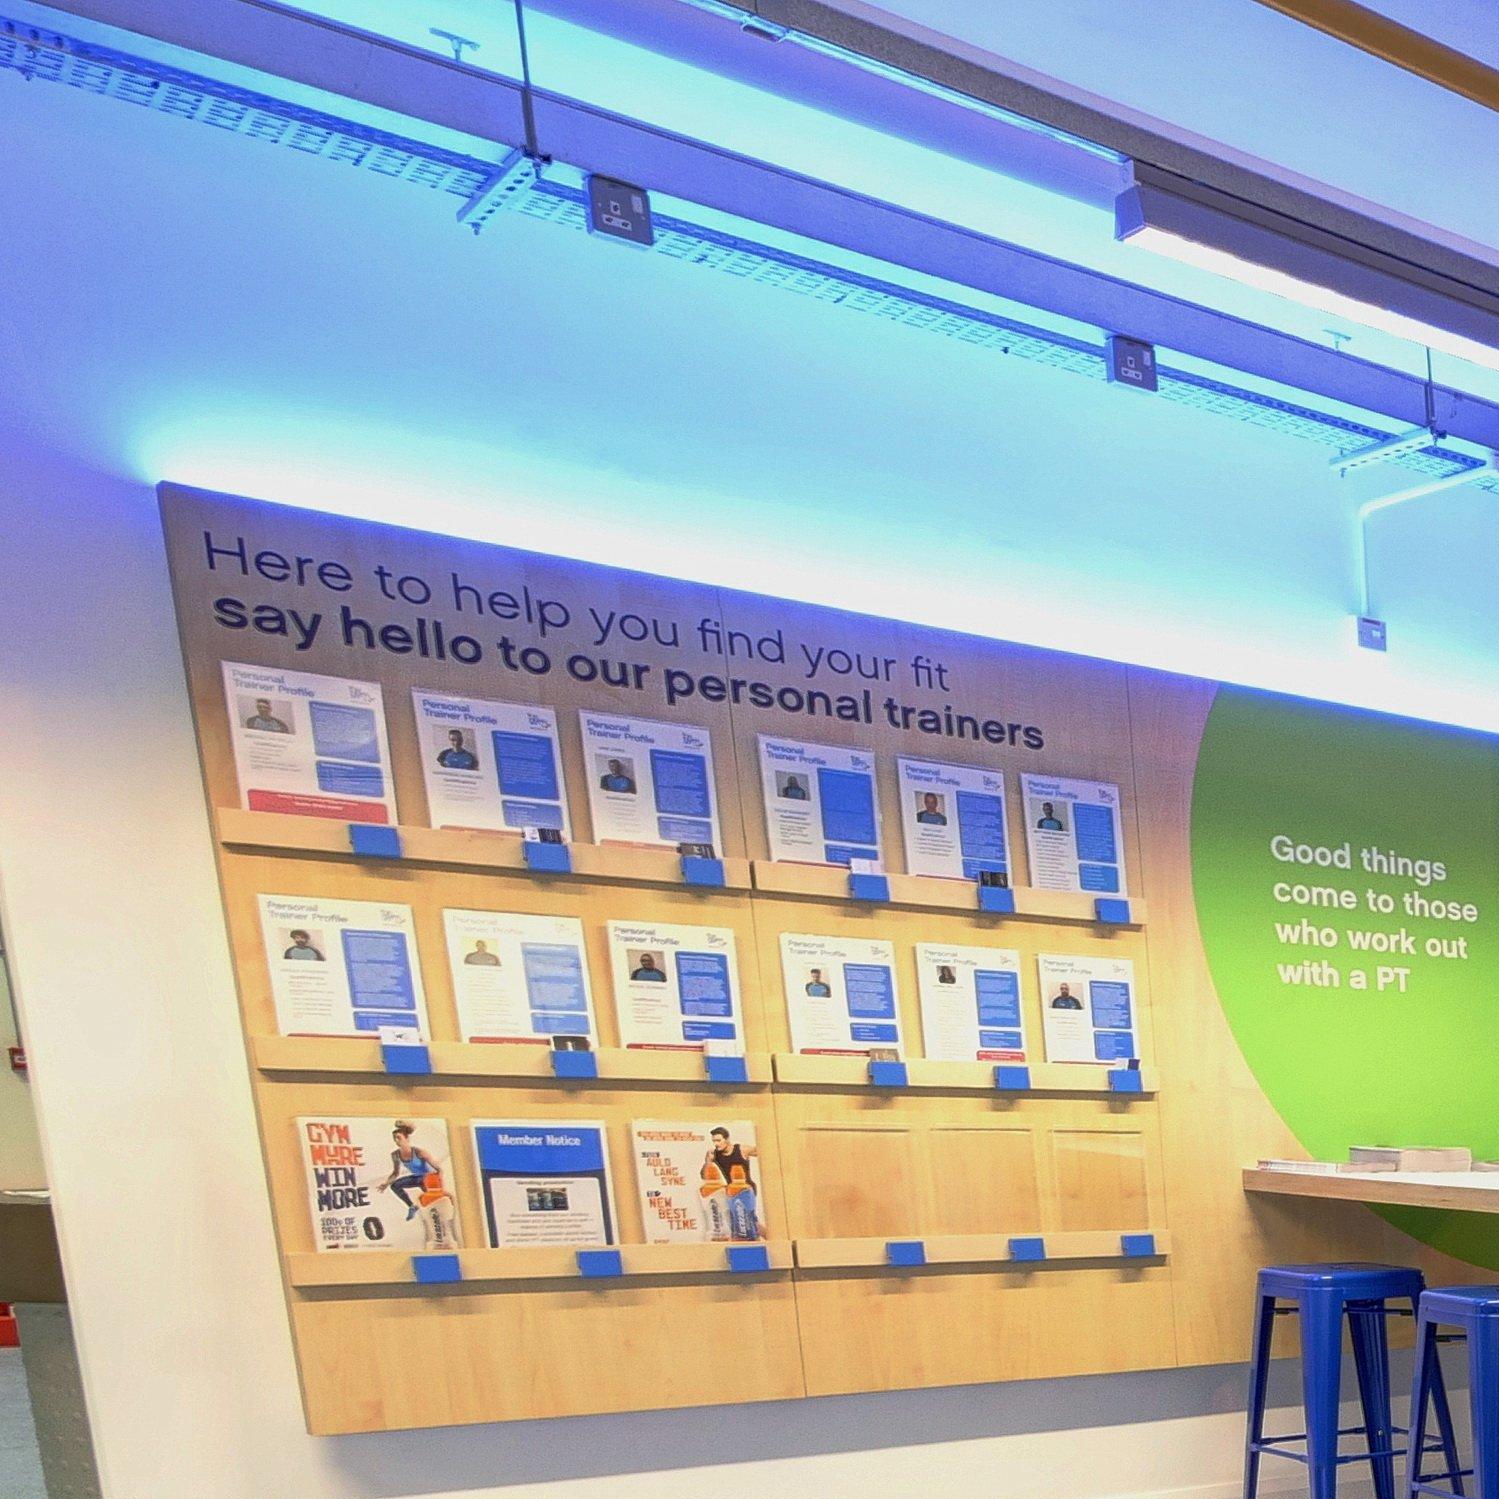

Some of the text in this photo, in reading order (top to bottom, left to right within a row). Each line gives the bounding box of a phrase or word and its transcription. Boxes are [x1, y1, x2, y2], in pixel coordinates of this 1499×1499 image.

[204, 531, 950, 692] Here to help you find your fit
[213, 596, 1045, 750] say hello to our personal trainers
[422, 699, 470, 712] Personal
[586, 719, 630, 732] Personal
[1270, 835, 1447, 886] Good things
[1273, 882, 1478, 922] come to those
[1275, 918, 1468, 959] who work out
[1277, 959, 1411, 992] with a PT
[497, 1134, 581, 1146] Member Notice
[314, 1167, 357, 1188] WIN
[317, 1186, 371, 1212] MORE
[658, 1208, 687, 1220] BEST
